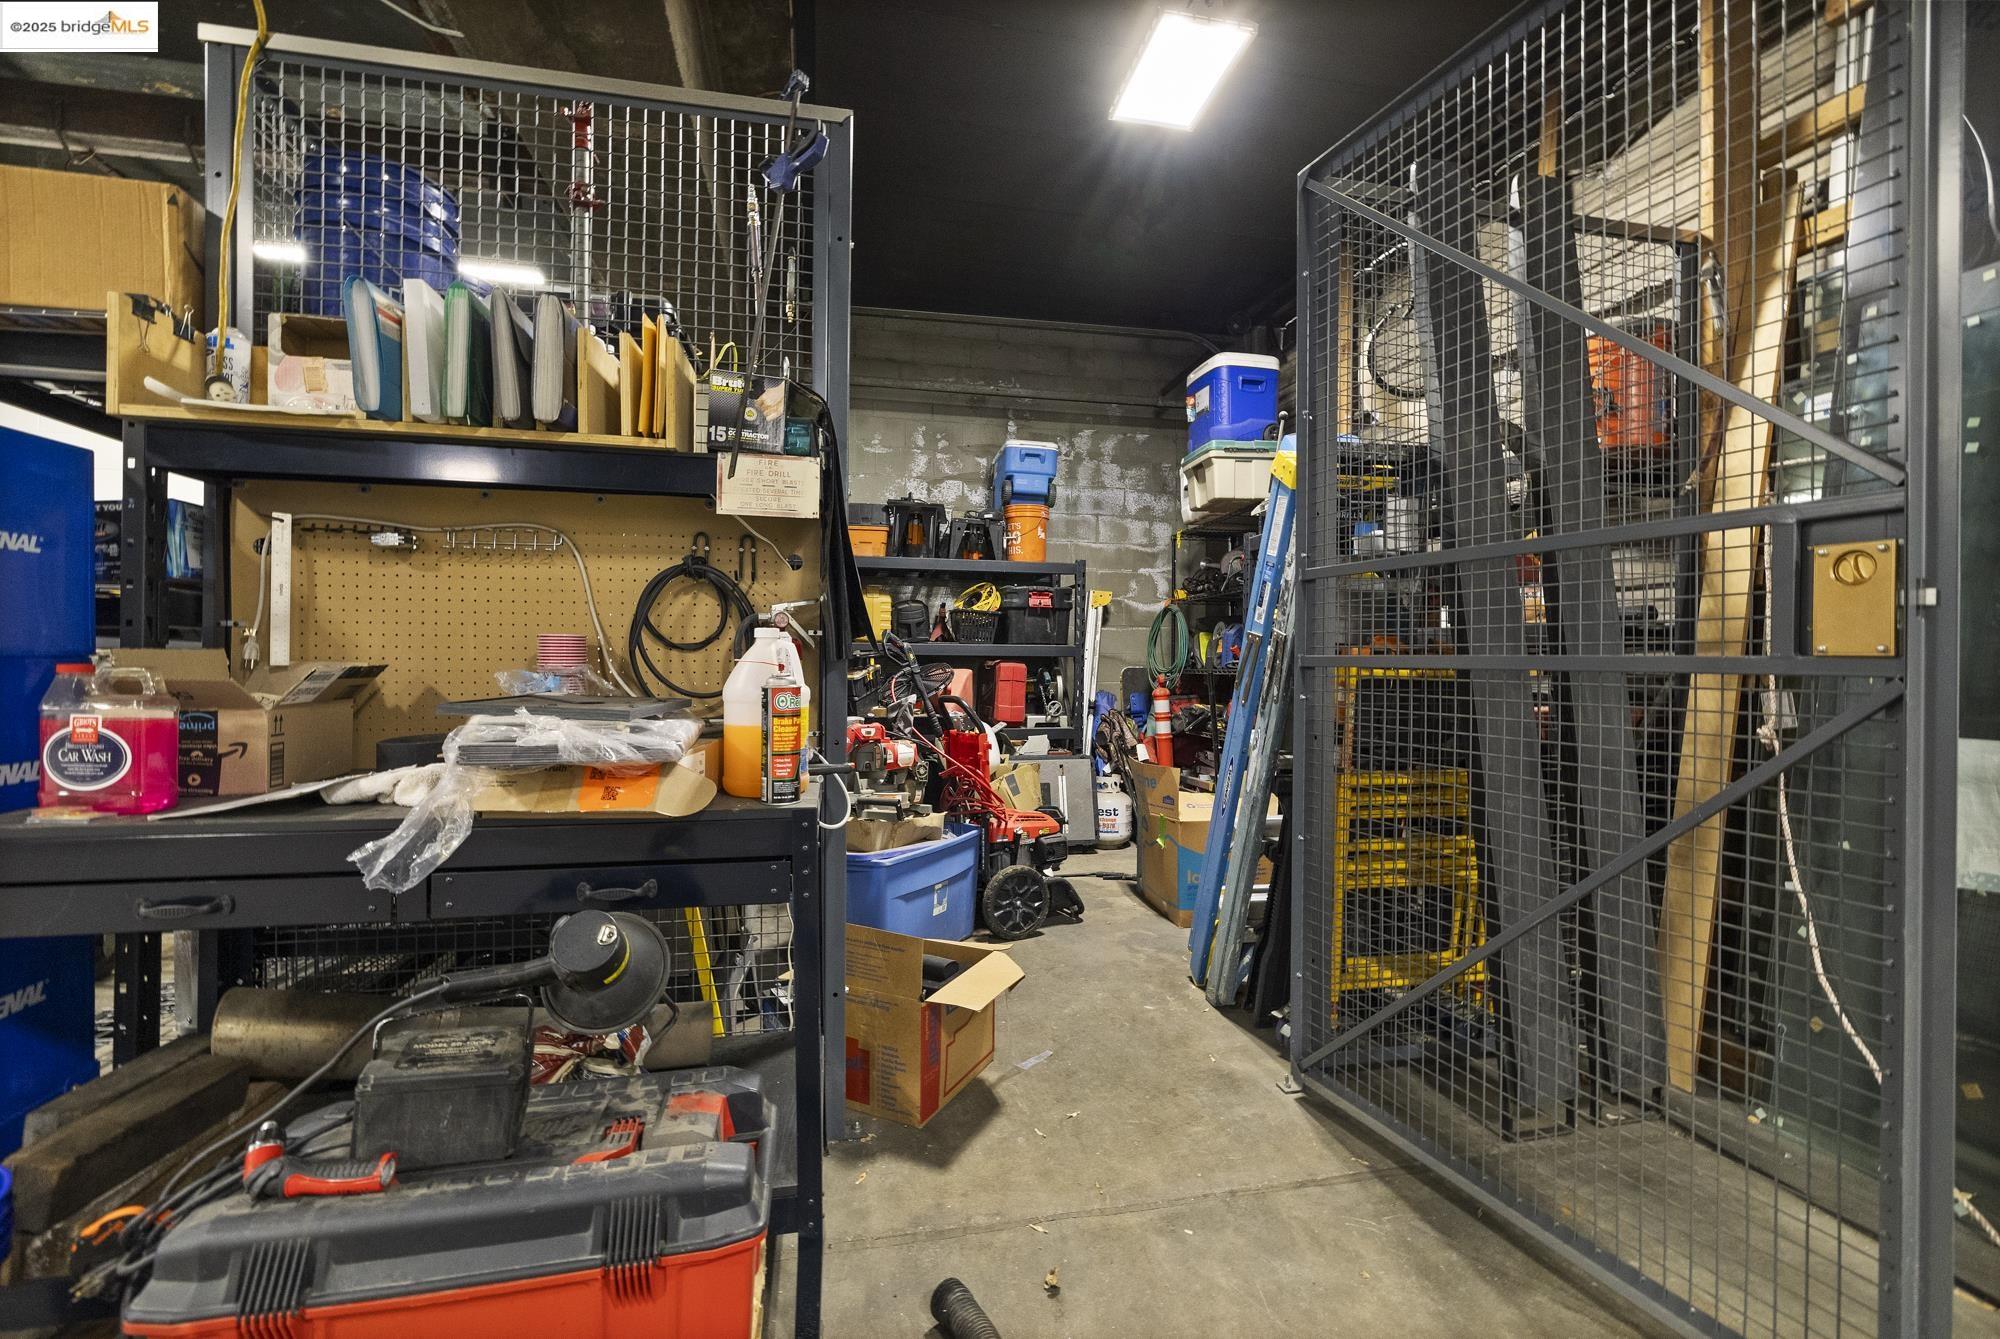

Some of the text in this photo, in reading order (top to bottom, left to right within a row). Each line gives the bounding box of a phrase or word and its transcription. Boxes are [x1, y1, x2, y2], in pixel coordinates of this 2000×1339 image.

[709, 425, 727, 442] 15
[746, 469, 792, 478] FIRE DRILL
[0, 531, 41, 554] NAL
[1008, 545, 1024, 555] HIS.
[80, 748, 111, 762] WASH
[0, 760, 40, 787] NAL
[1097, 807, 1119, 817] est
